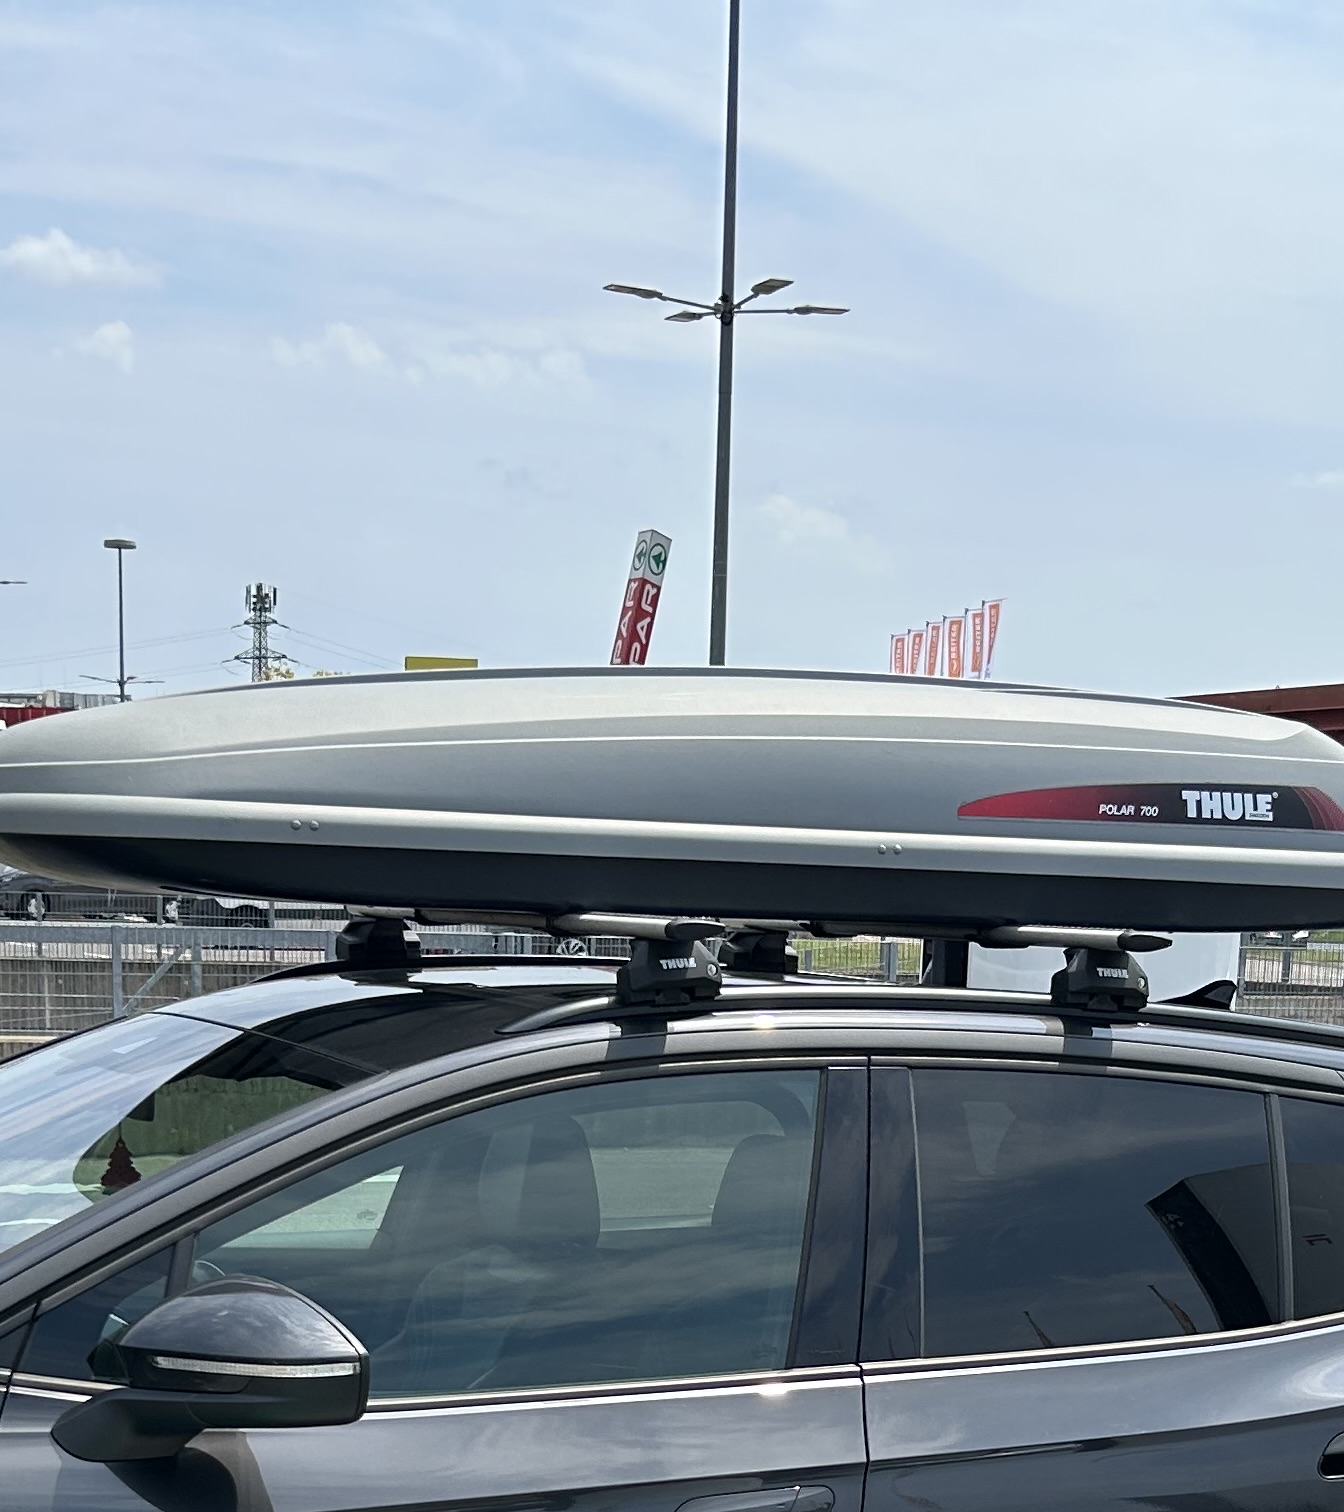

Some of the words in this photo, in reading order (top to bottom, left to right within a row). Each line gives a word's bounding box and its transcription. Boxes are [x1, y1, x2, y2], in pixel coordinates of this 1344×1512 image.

[1098, 804, 1135, 816] POLAR
[1140, 805, 1159, 817] 700
[1181, 789, 1274, 822] THULE
[659, 957, 697, 970] THULE
[1096, 967, 1129, 979] THULE
